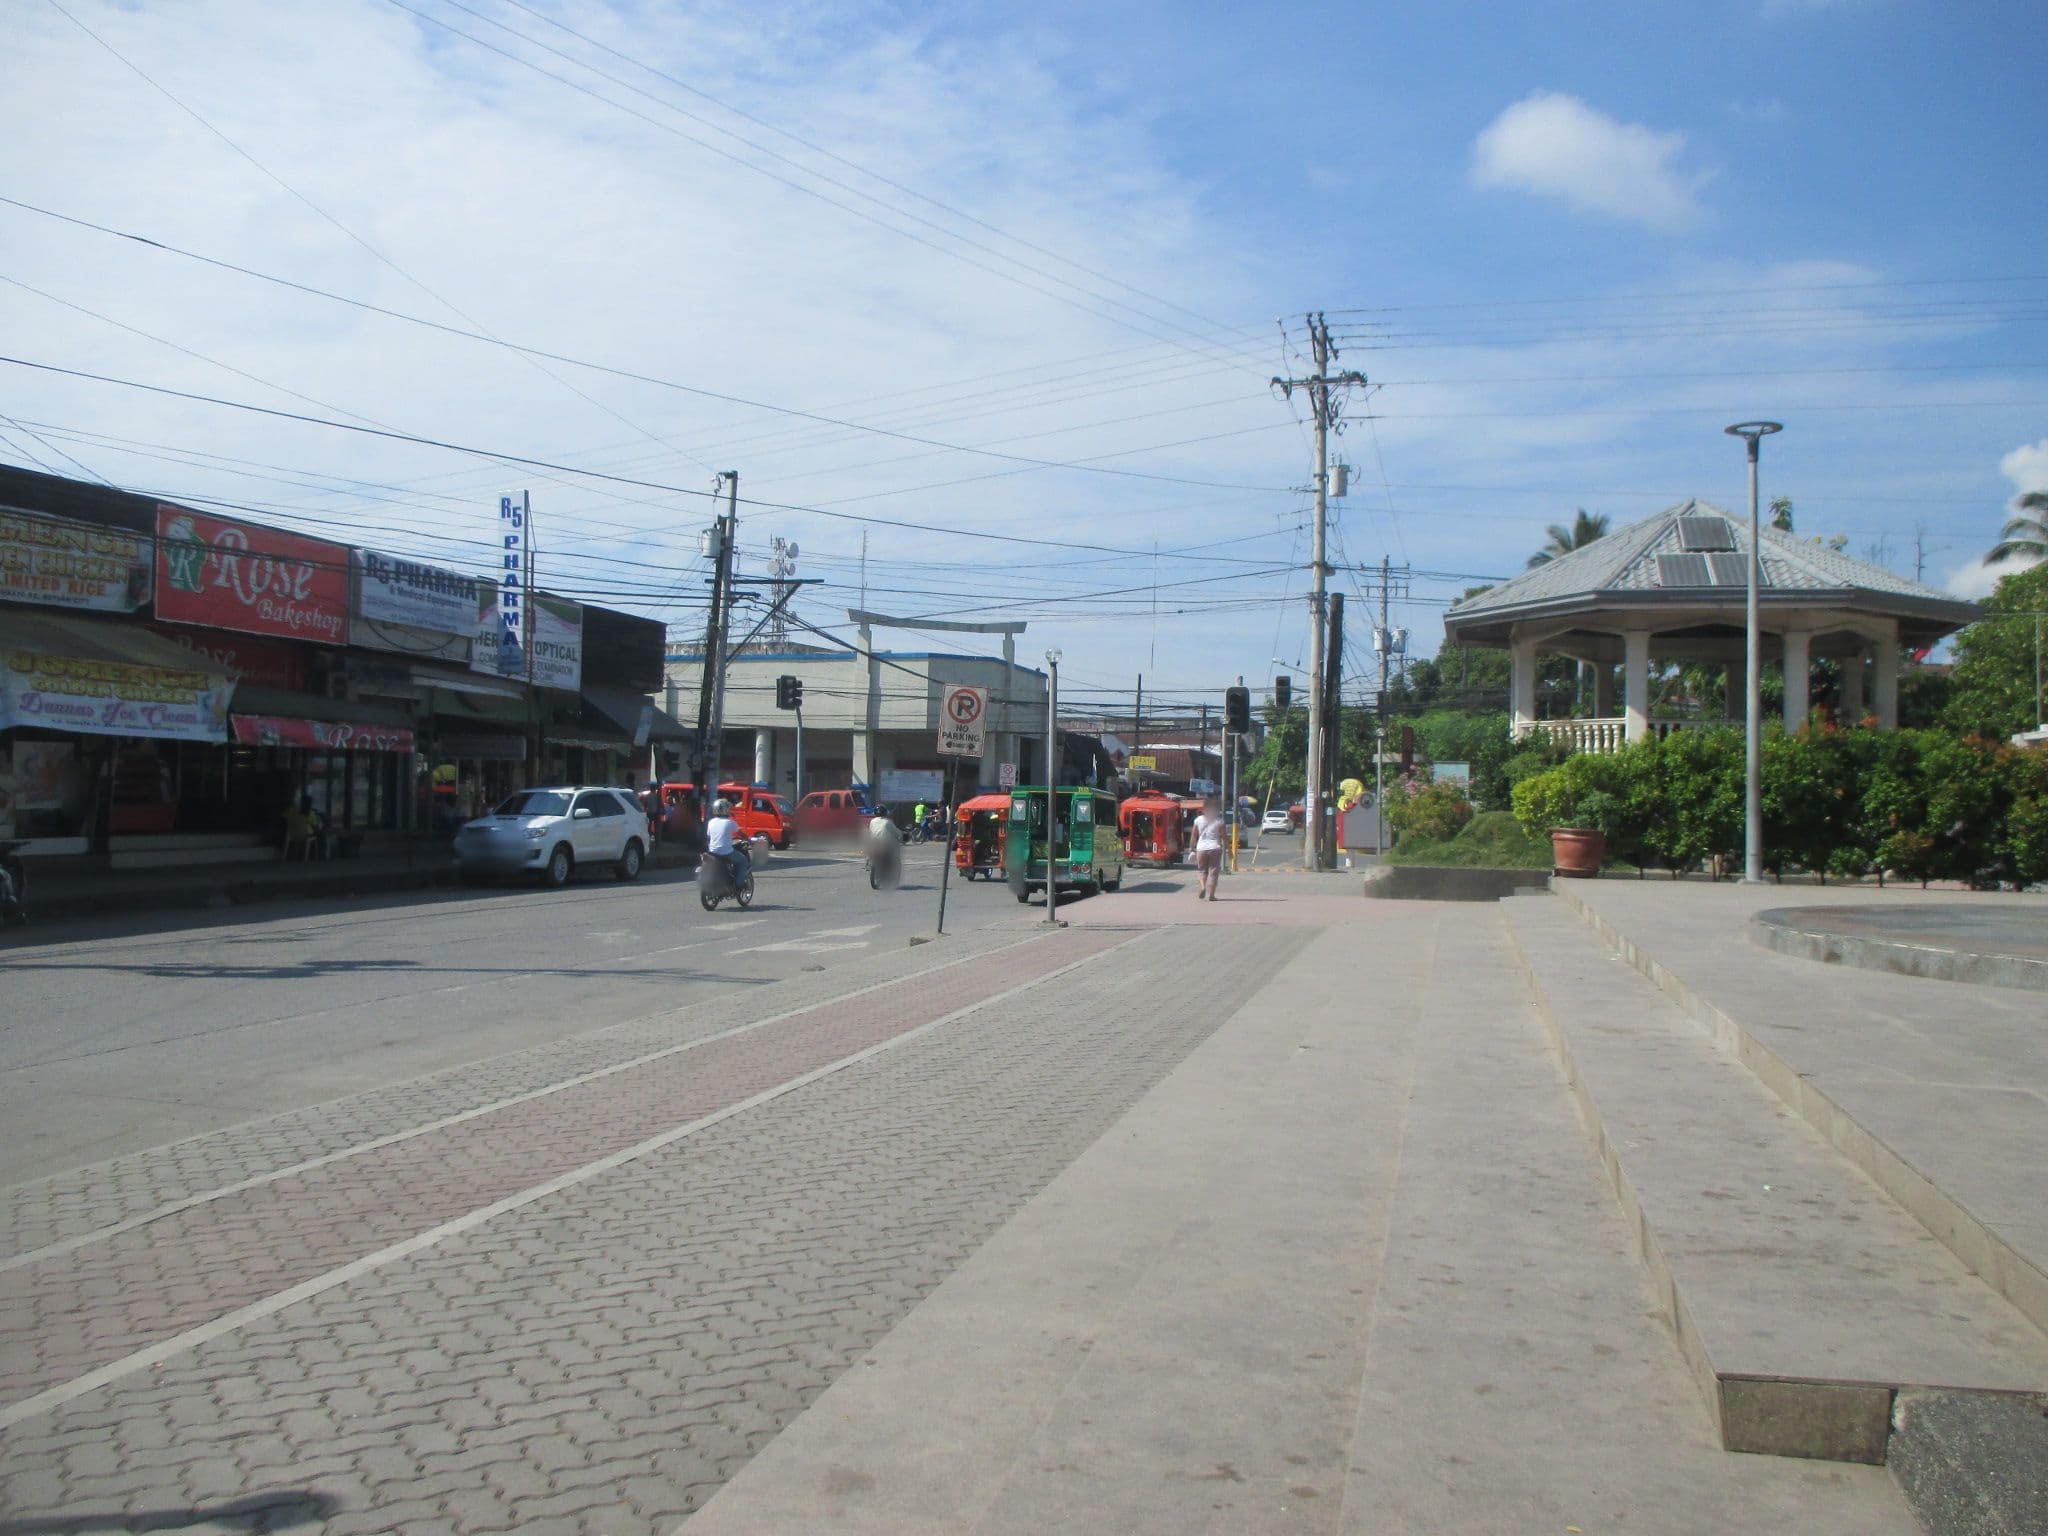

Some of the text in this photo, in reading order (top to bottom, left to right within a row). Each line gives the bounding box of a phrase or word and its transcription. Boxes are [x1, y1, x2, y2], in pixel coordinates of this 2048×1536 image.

[501, 497, 522, 528] R5
[211, 528, 315, 605] Rose
[68, 579, 105, 597] RICE
[503, 535, 519, 645] PHARMA
[257, 599, 342, 637] Bakeshop
[534, 641, 577, 661] OPTICAL
[942, 731, 980, 742] PARKING
[956, 725, 969, 733] NO
